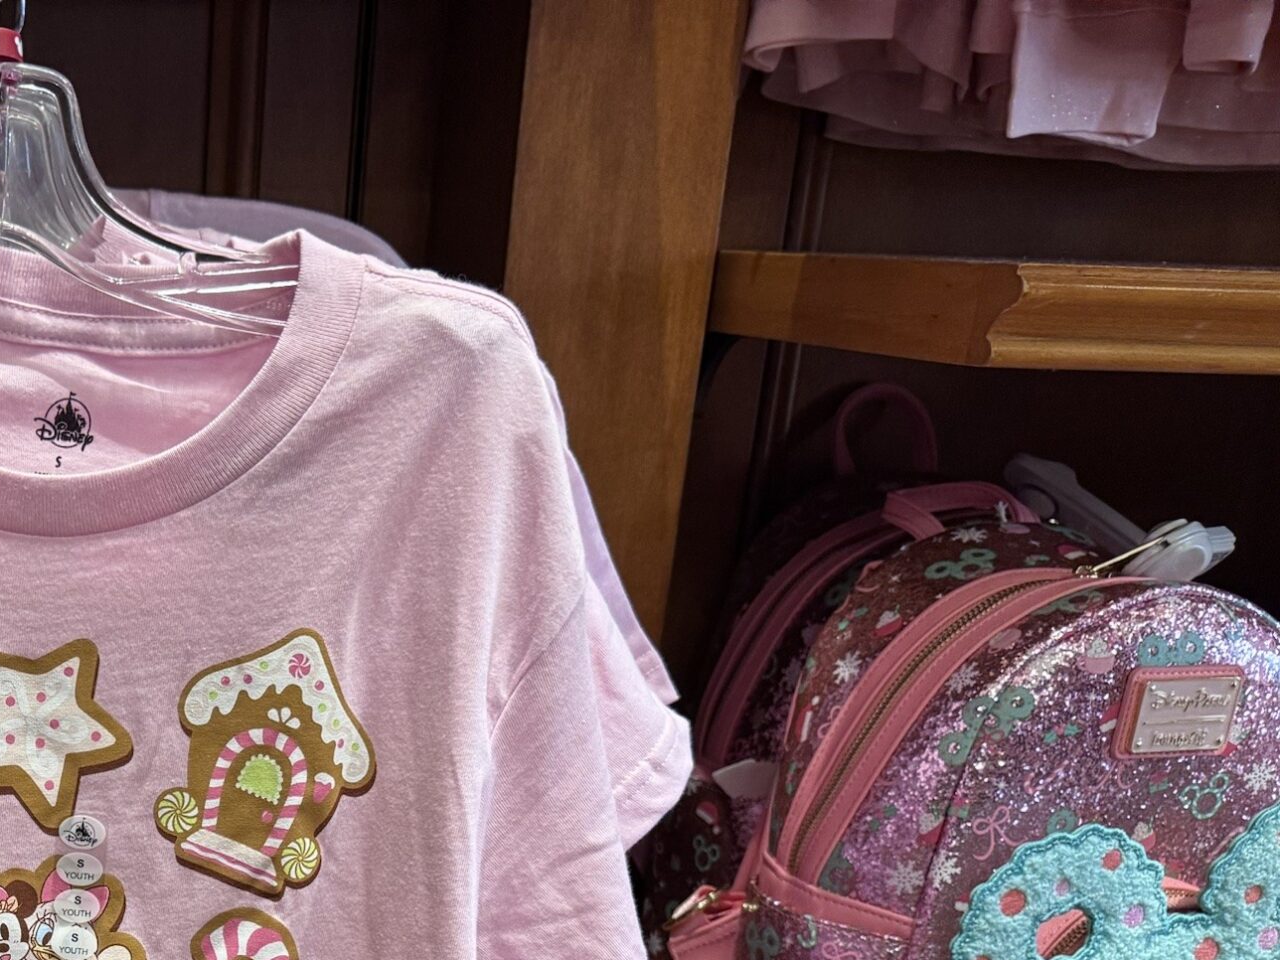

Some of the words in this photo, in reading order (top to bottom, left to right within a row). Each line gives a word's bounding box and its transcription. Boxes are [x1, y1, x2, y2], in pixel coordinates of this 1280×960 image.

[33, 417, 94, 452] Disney
[55, 456, 62, 468] S
[76, 858, 85, 868] S
[64, 871, 95, 880] YOUTH
[74, 895, 82, 905] S
[61, 909, 92, 918] YOUTH
[71, 933, 79, 942] S
[59, 945, 89, 955] YOUTH
